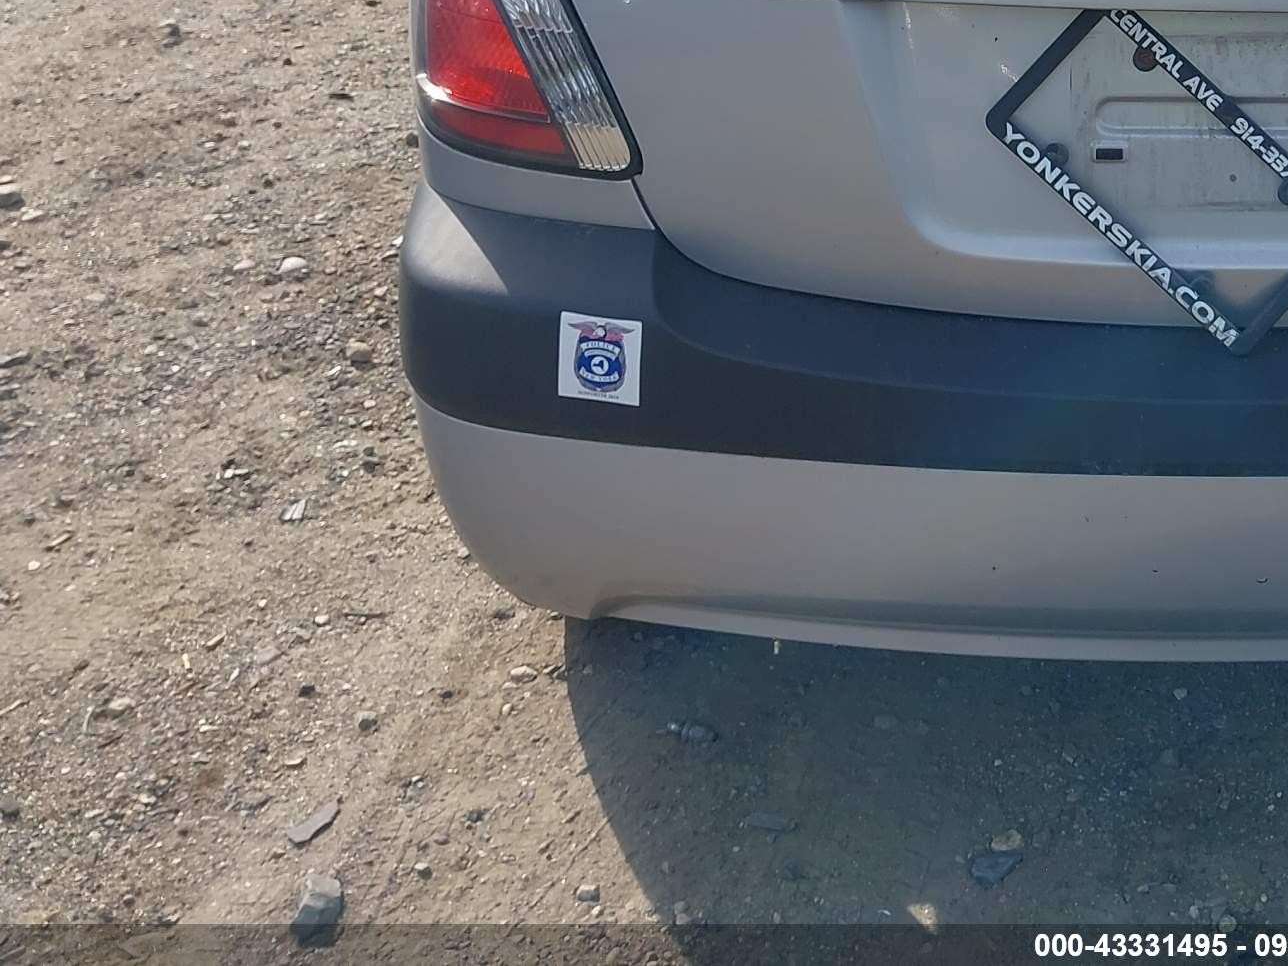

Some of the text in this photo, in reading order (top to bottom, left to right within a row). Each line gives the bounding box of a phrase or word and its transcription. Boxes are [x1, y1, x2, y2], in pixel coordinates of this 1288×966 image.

[1110, 9, 1184, 79] CENTRAL
[1184, 75, 1224, 112] AVE
[1002, 121, 1241, 349] YONKERSKIA.COM
